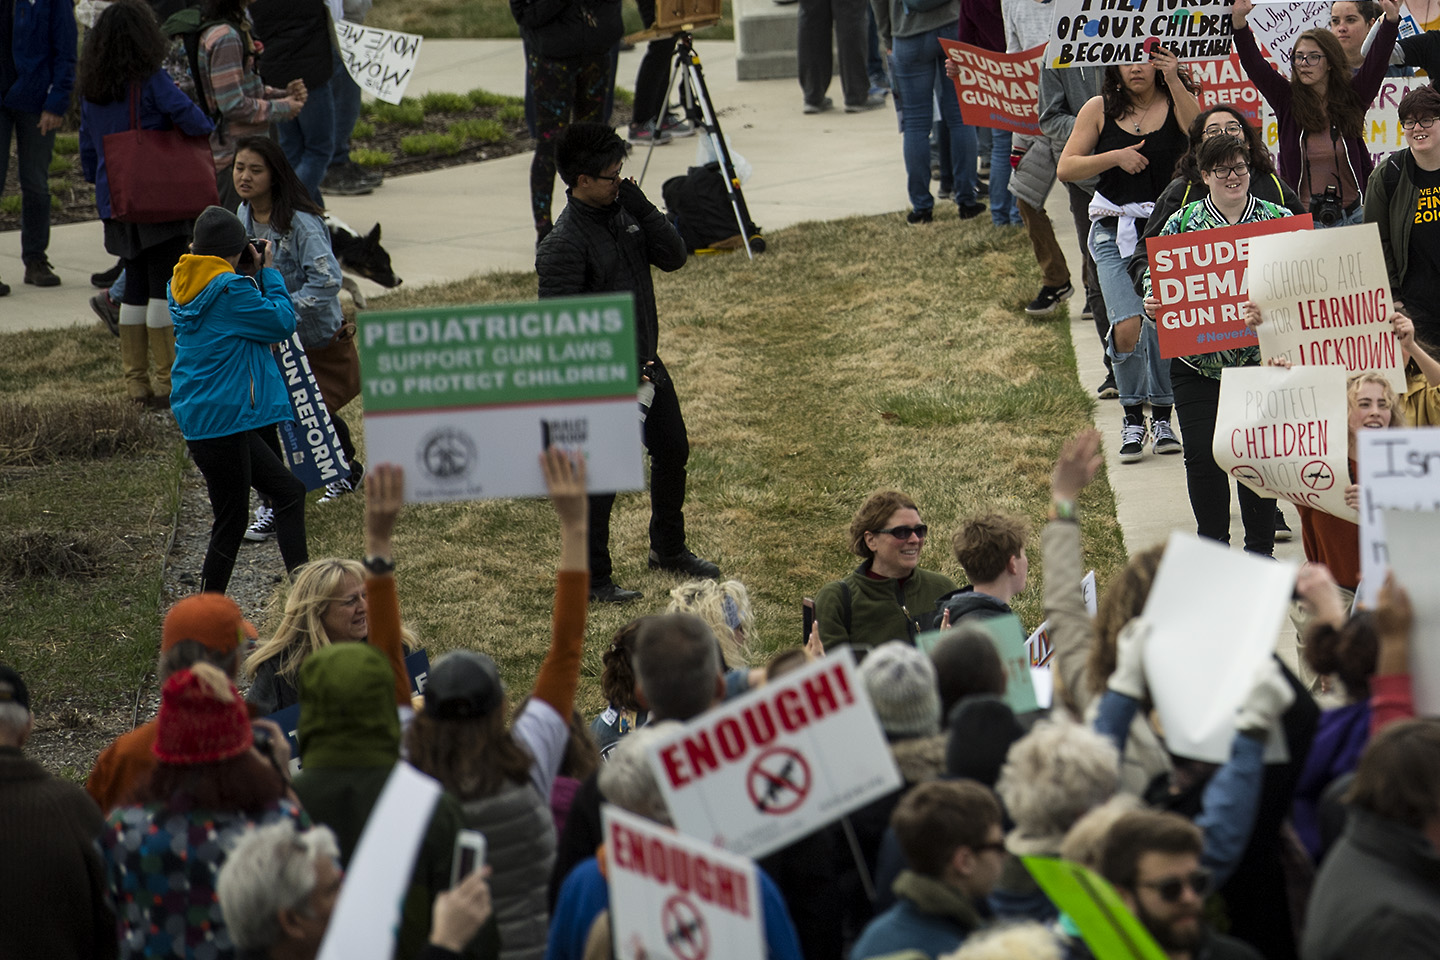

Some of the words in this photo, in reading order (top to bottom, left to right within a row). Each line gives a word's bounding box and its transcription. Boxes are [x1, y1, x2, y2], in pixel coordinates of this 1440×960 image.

[1056, 14, 1089, 41] OF
[1097, 14, 1146, 39] OUR
[1270, 25, 1300, 50] more
[1058, 42, 1145, 65] BECOME
[961, 89, 1001, 110] GUN
[1262, 256, 1329, 302] SCHOOLS
[1336, 251, 1366, 290] ARE
[363, 307, 623, 347] PEDIATRICIANS
[1161, 305, 1217, 331] GUN
[1270, 305, 1293, 337] FOR
[1298, 287, 1388, 332] LEARNING
[377, 347, 486, 373] SUPPORT
[493, 344, 542, 366] GUN
[548, 339, 613, 362] LAWS
[1298, 330, 1397, 372] LOCKDOWN
[367, 378, 398, 397] TO
[404, 370, 507, 394] PROTECT
[513, 364, 628, 388] CHILDREN
[1245, 384, 1319, 421] PROTECT
[292, 386, 339, 482] REFORM
[1230, 418, 1329, 460] CHILDREN
[1261, 459, 1301, 490] NOT
[658, 663, 857, 791] ENOUGH!
[609, 822, 752, 920] ENOUGH!
